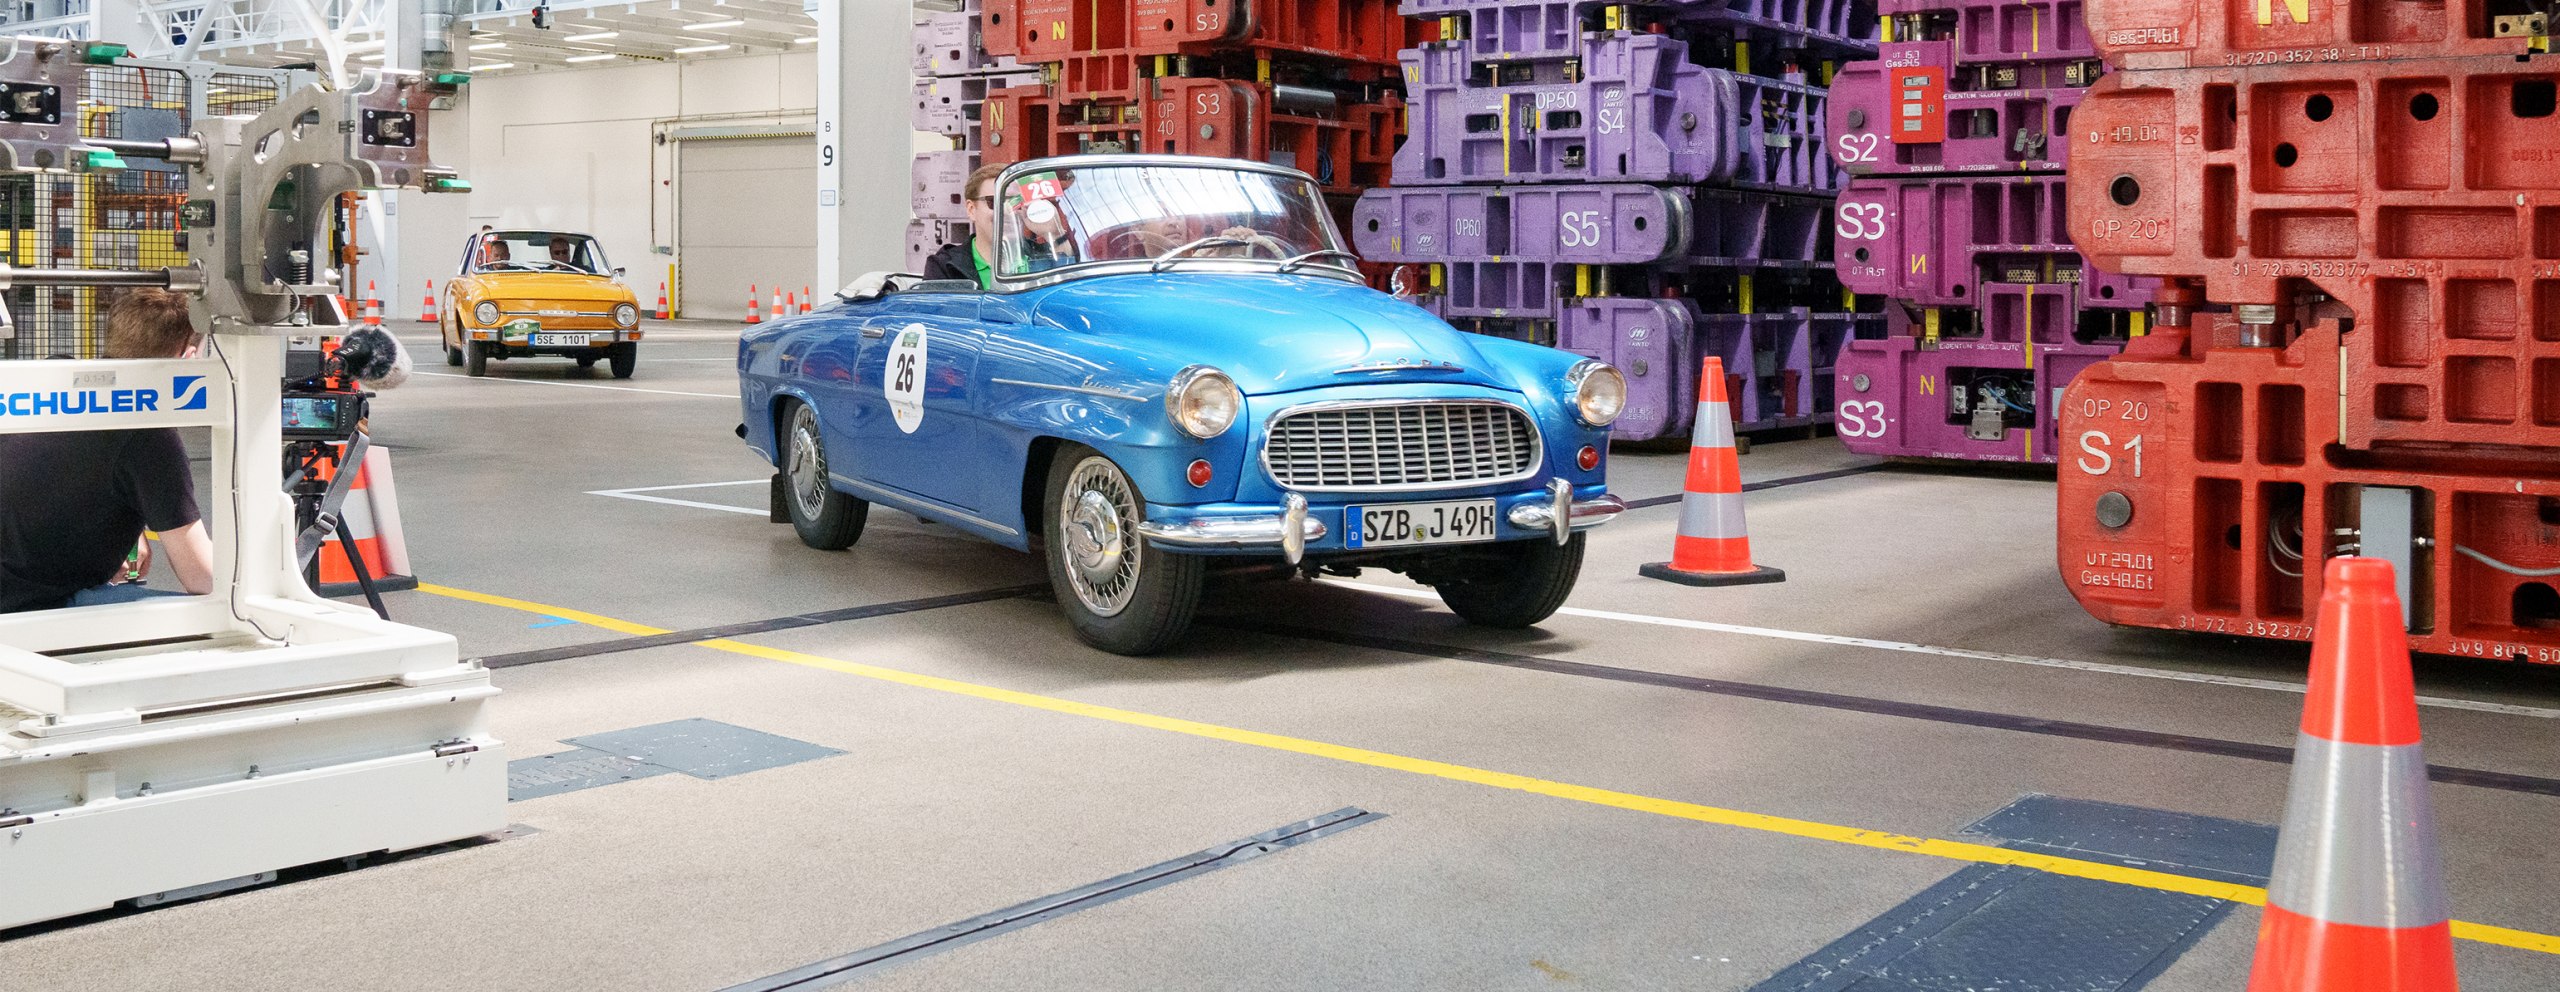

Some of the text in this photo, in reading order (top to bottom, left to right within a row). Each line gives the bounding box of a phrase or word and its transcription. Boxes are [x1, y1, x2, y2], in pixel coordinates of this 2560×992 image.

[1052, 20, 1066, 40] N
[1196, 13, 1219, 31] S3
[1408, 66, 1419, 83] N
[1197, 93, 1220, 115] S3
[1535, 91, 1577, 109] OP50
[989, 101, 1004, 130] N
[1158, 102, 1175, 119] OP
[825, 121, 831, 132] B
[1157, 119, 1174, 136] 40
[1597, 108, 1625, 135] S4
[823, 144, 833, 166] 9
[1838, 132, 1878, 163] S2
[1027, 180, 1056, 199] 26
[934, 219, 949, 239] S1
[1455, 218, 1481, 237] OP60
[1561, 211, 1600, 247] S5
[1836, 202, 1885, 240] S3
[2092, 219, 2158, 239] OP 20
[1391, 236, 1400, 253] N
[537, 335, 585, 345] 5SE 1101
[895, 353, 915, 393] 26
[1919, 374, 1935, 396] N
[1838, 400, 1887, 439] S3
[2083, 398, 2149, 421] OP 20
[2077, 430, 2142, 478] S1
[1351, 505, 1494, 542] D SZB J 49H
[2087, 553, 2108, 566] UT
[2245, 622, 2313, 639] 352377
